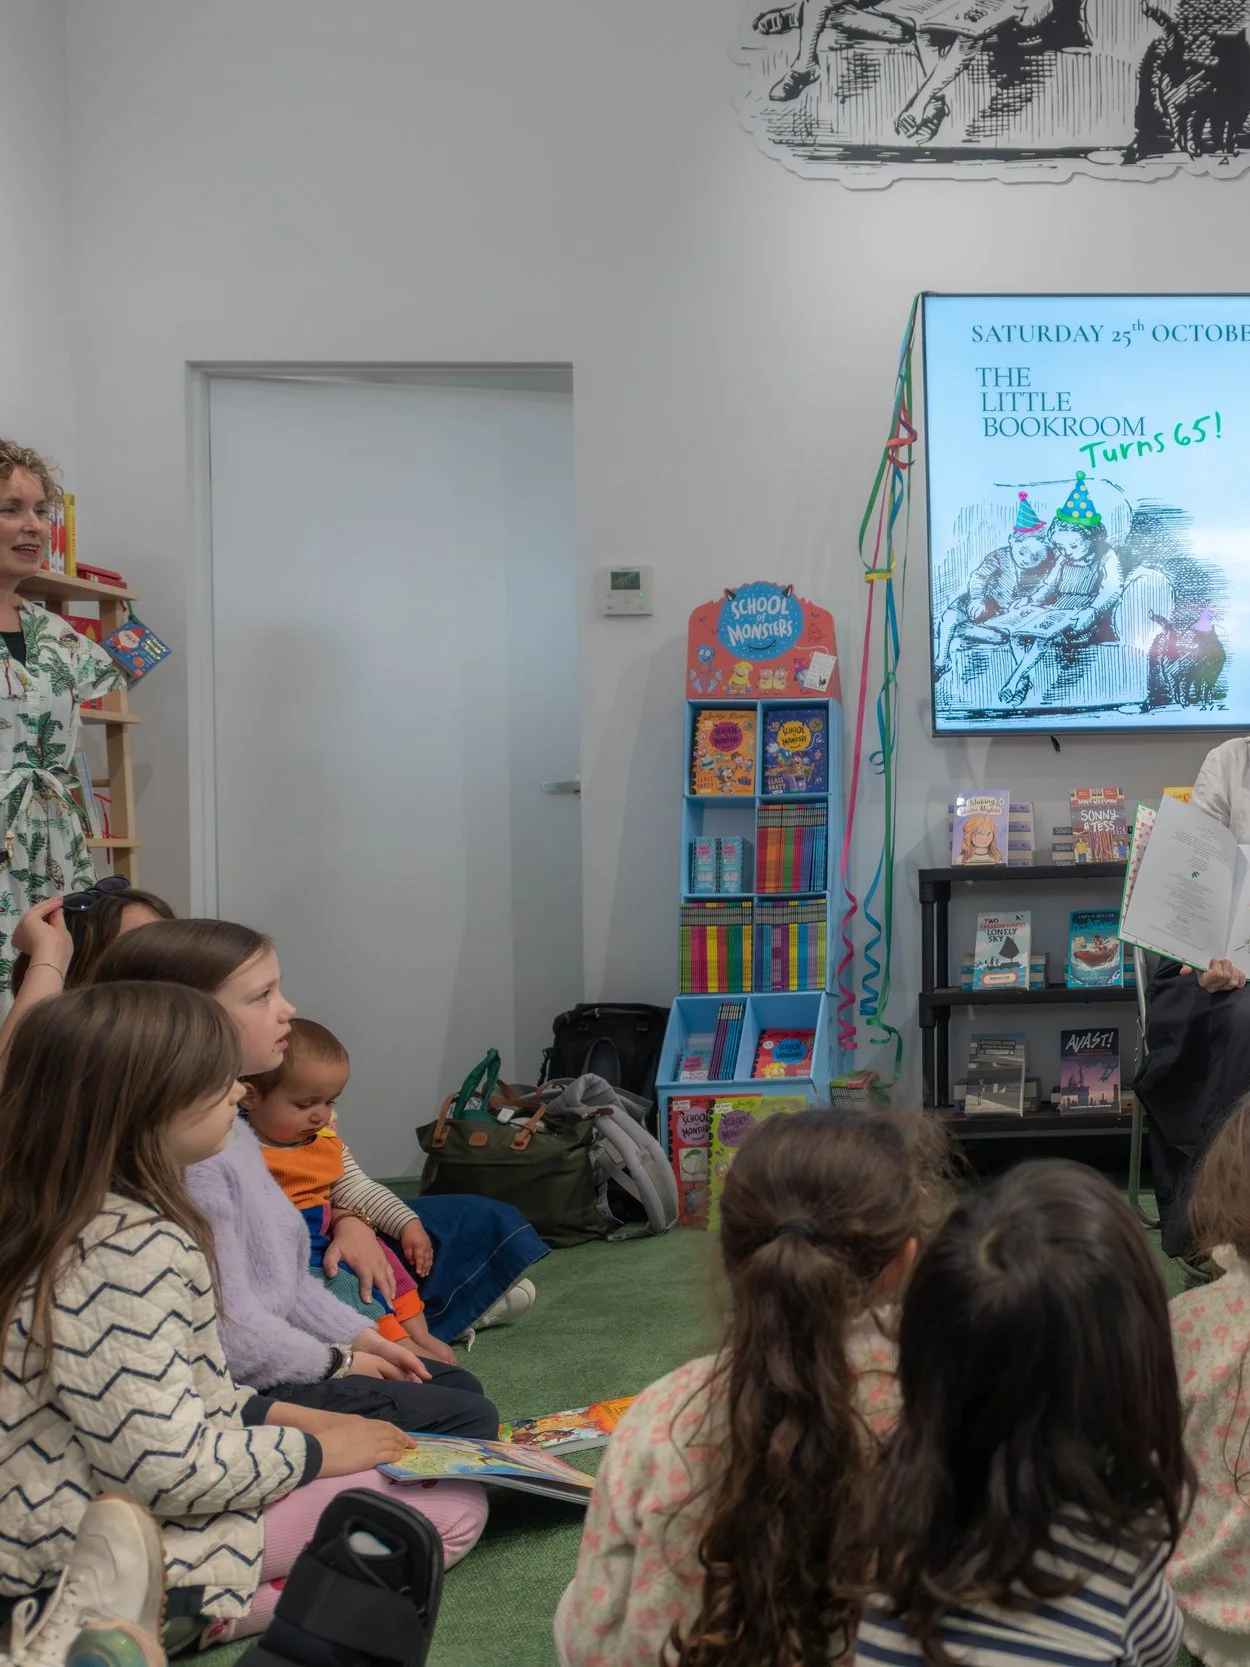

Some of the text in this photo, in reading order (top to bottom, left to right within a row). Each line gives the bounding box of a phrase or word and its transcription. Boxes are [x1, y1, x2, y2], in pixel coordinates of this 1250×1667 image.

[971, 324, 1104, 343] SATURDAY
[1111, 319, 1145, 348] 25th
[975, 366, 1031, 388] THE
[980, 391, 1072, 412] LITTLE
[983, 416, 1147, 438] BOOKROOM
[1079, 410, 1222, 469] Turns 65!
[730, 595, 790, 620] SCHOOL
[727, 619, 793, 647] MONSTERS
[1080, 808, 1119, 824] SONNY
[1090, 820, 1116, 833] TESS
[986, 928, 1017, 936] LONELY
[988, 935, 1004, 943] SKY
[1065, 1031, 1115, 1053] AVAST!
